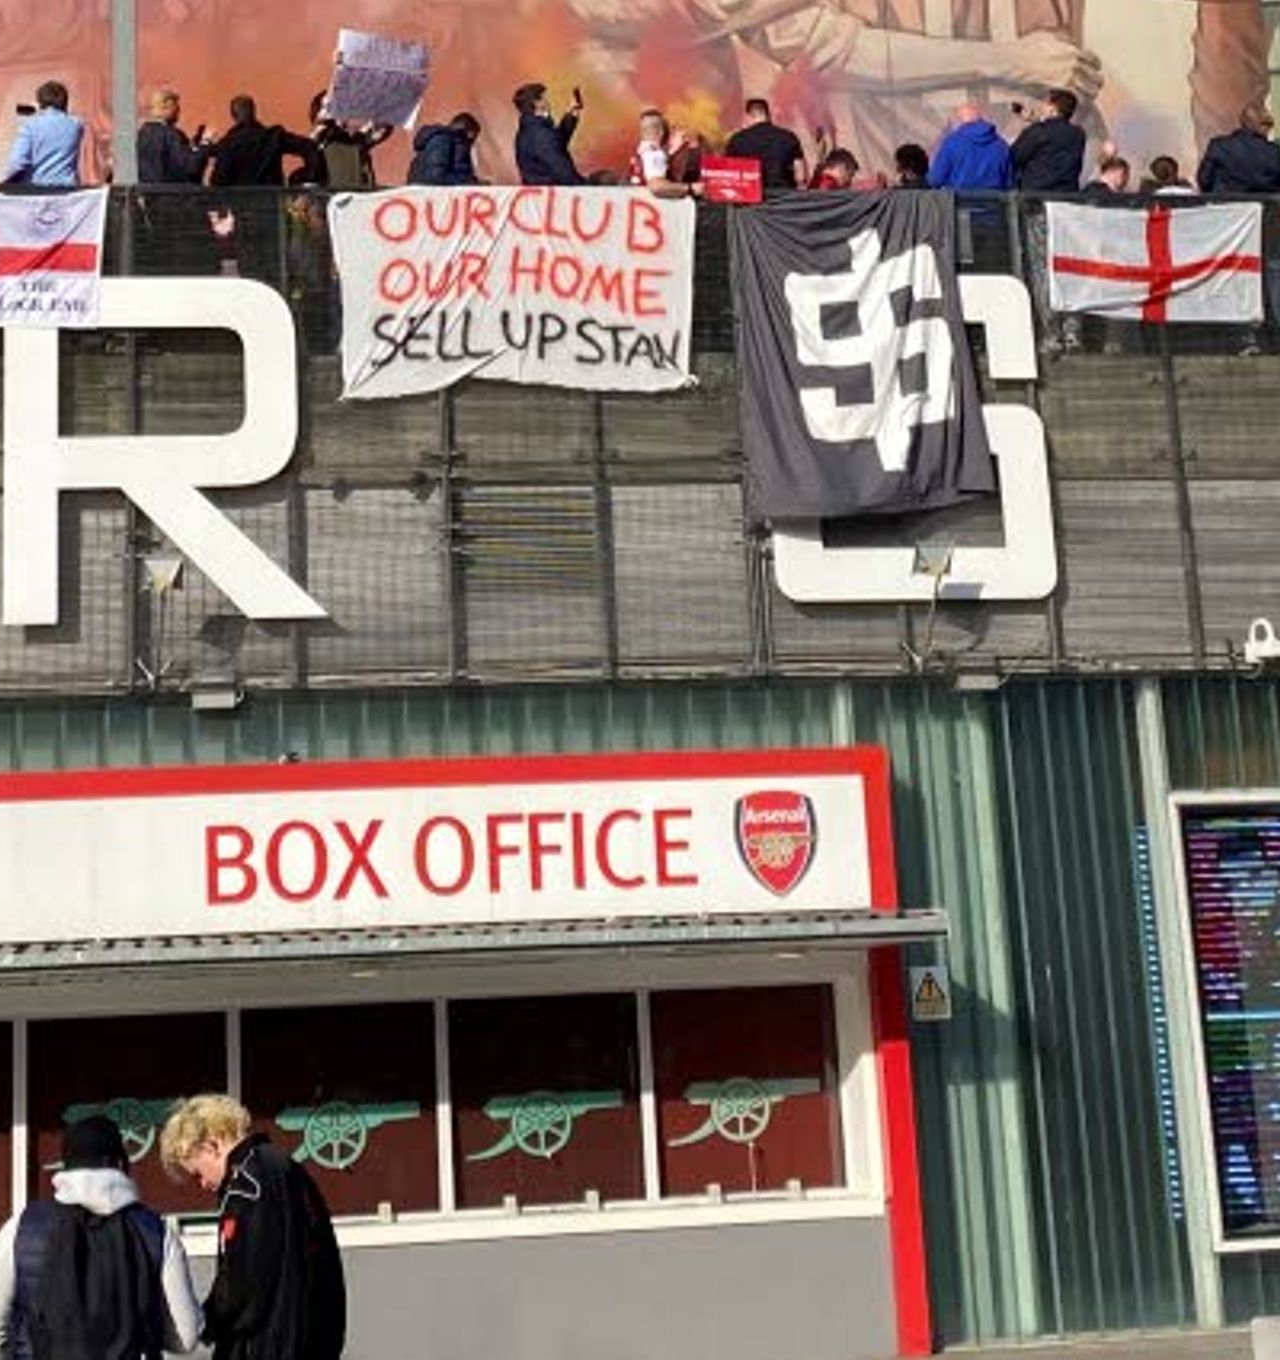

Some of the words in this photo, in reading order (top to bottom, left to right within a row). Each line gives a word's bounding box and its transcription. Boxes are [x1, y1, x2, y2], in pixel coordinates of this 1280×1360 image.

[373, 194, 495, 243] OUR
[506, 188, 667, 254] CLUB
[378, 253, 490, 306] OUR
[508, 245, 672, 318] HOME
[371, 309, 494, 368] SELL
[500, 313, 568, 352] UP
[574, 318, 685, 371] STAN
[745, 809, 804, 824] Arsenal
[203, 818, 391, 906] BOX
[413, 808, 699, 898] OFFICE
